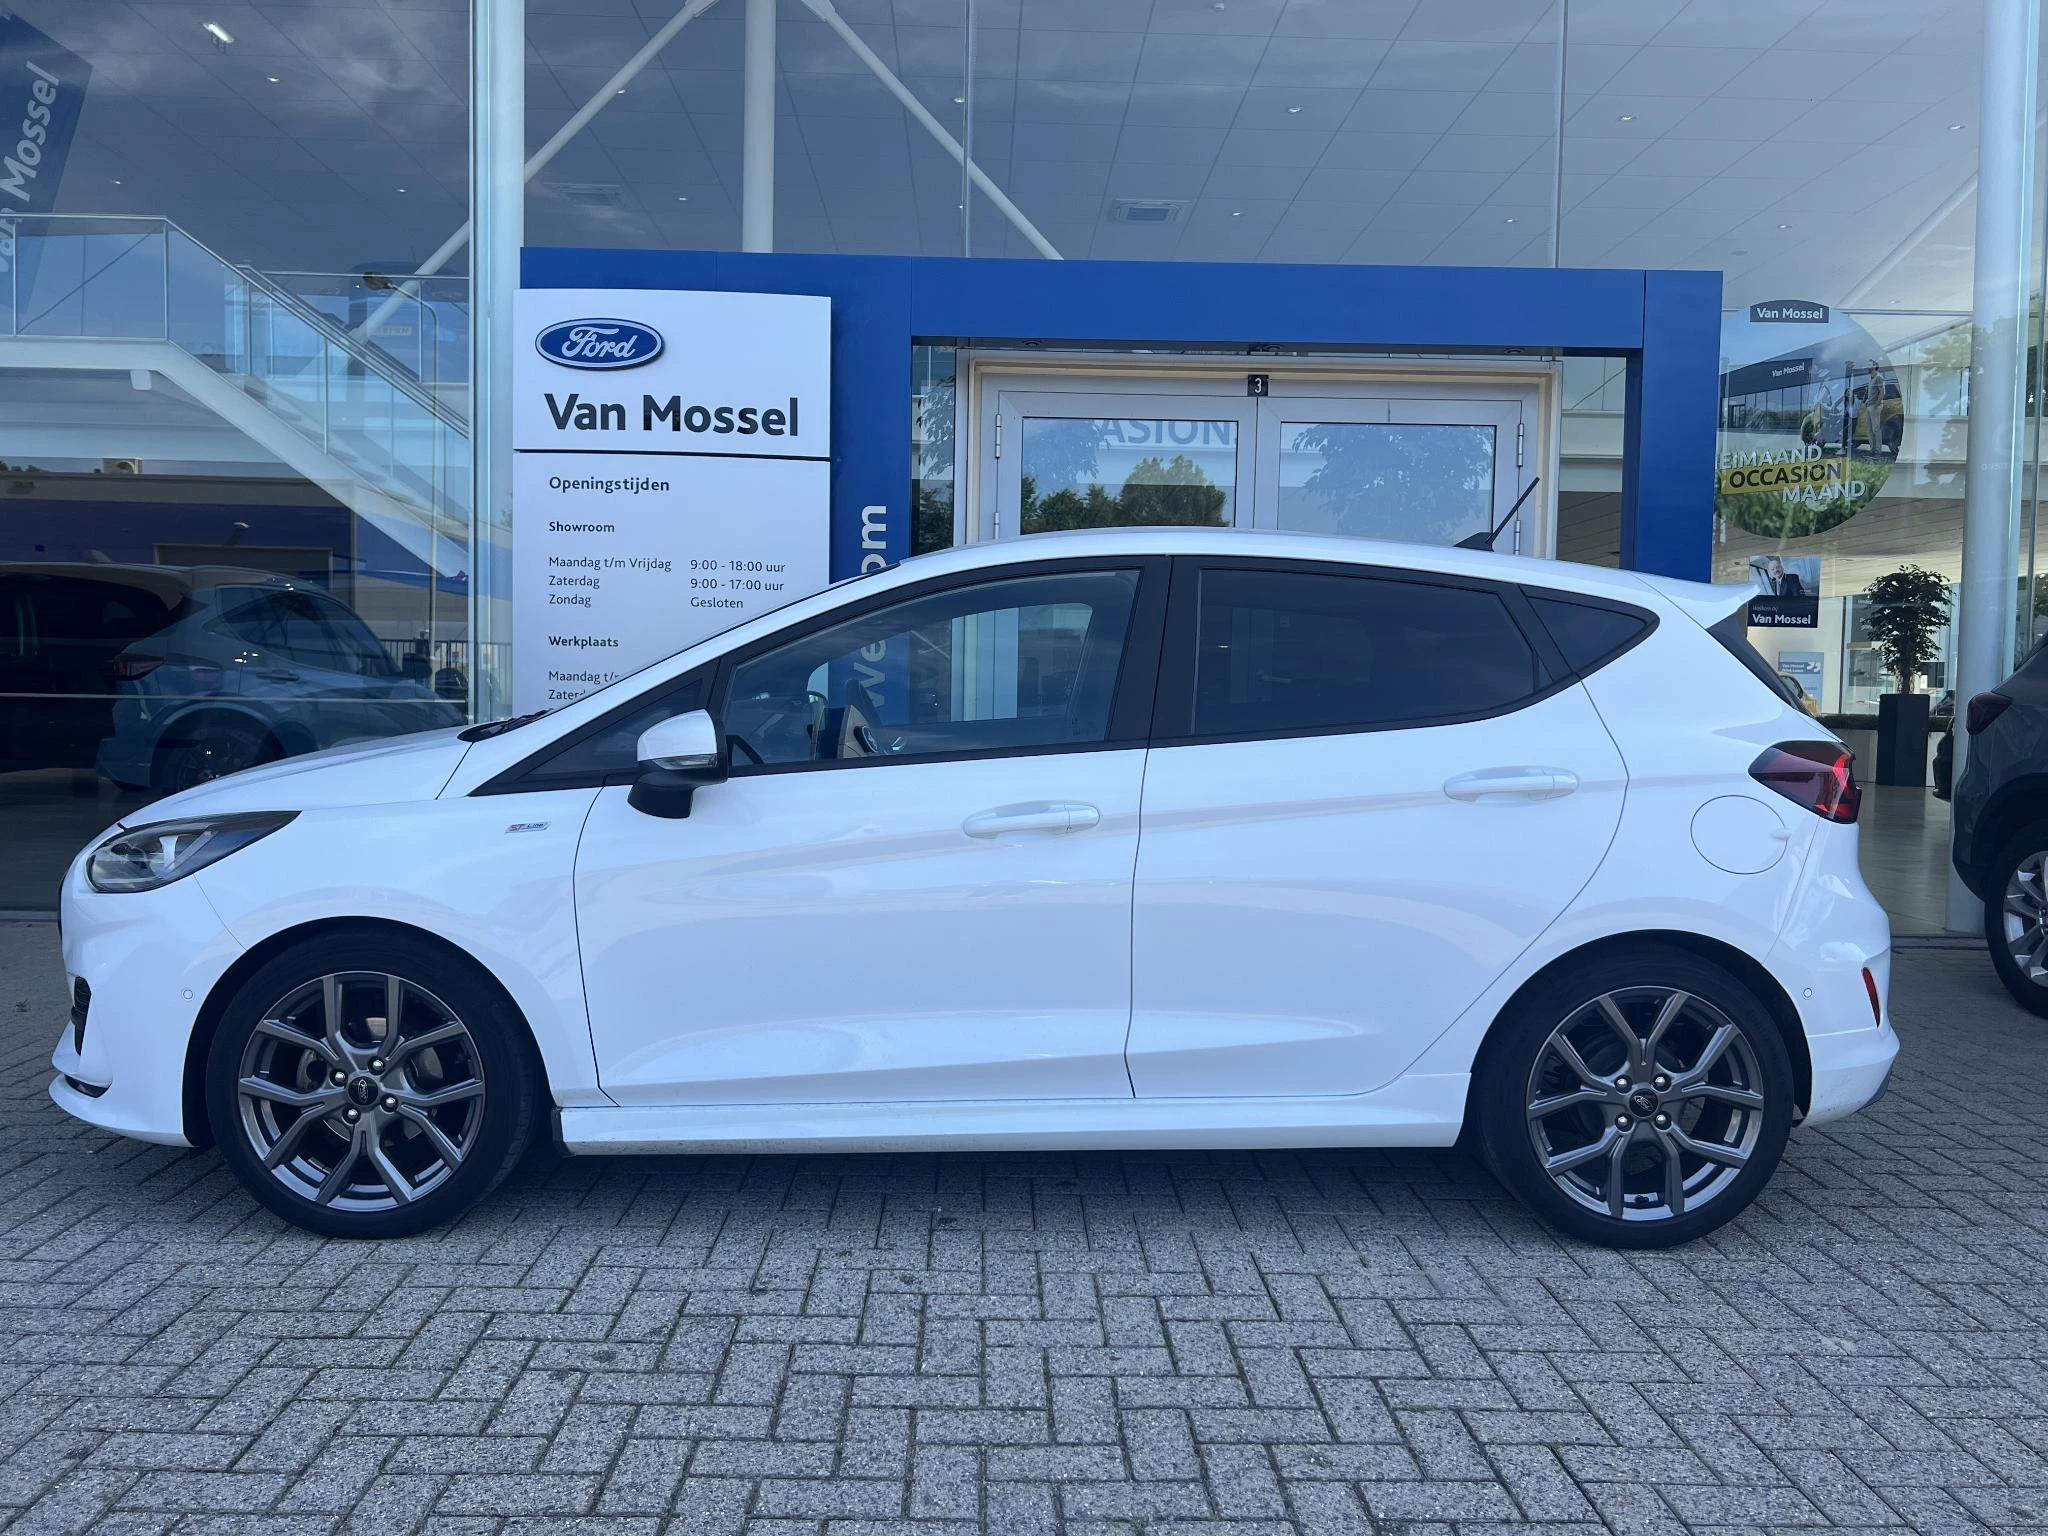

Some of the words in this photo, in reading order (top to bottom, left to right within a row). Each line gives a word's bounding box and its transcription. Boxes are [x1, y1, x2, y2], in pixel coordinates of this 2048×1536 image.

[0, 61, 60, 202] Mossel
[1757, 308, 1779, 318] Van
[1782, 307, 1823, 319] Mossel
[561, 326, 638, 358] Ford
[1255, 378, 1262, 393] 3
[544, 393, 627, 431] Van
[642, 394, 799, 437] Mossel
[1729, 462, 1842, 488] OCCASION
[549, 476, 670, 494] Openingstijden
[1782, 480, 1866, 503] MAAND
[548, 521, 615, 533] Showroom
[549, 556, 601, 570] Maandag
[604, 557, 626, 568] t/m
[629, 557, 672, 572] Vrijdag
[690, 560, 718, 570] 9:00
[729, 561, 763, 571] 18:00
[766, 564, 786, 572] uur
[549, 575, 600, 589] Zaterdag
[690, 578, 718, 589] 9:00
[729, 580, 761, 590] 17:00
[549, 594, 592, 608] Zondag
[690, 597, 744, 608] Gesloten
[1752, 614, 1772, 624] Van
[1774, 615, 1811, 624] Mossel
[548, 635, 619, 650] Werkplaats
[548, 670, 601, 685] Maandag
[604, 671, 621, 682] t/
